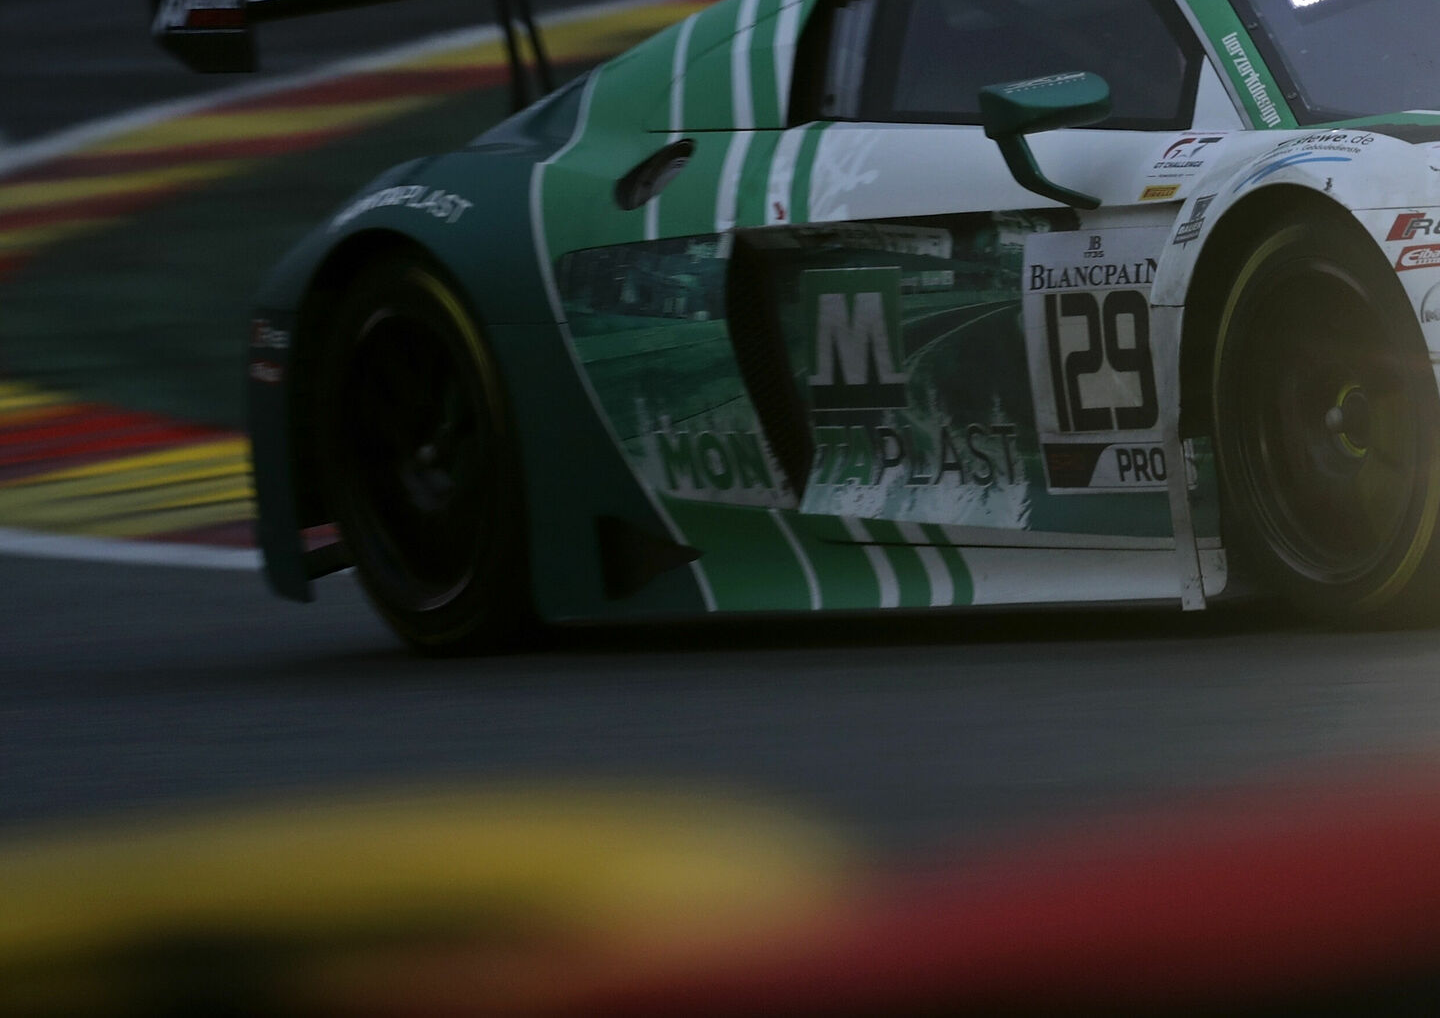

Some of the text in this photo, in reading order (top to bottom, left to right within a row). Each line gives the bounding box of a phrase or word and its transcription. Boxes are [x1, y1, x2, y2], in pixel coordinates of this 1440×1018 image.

[1029, 258, 1158, 291] BLANCPAIN
[1044, 289, 1160, 433] 129
[1115, 446, 1167, 482] PRO
